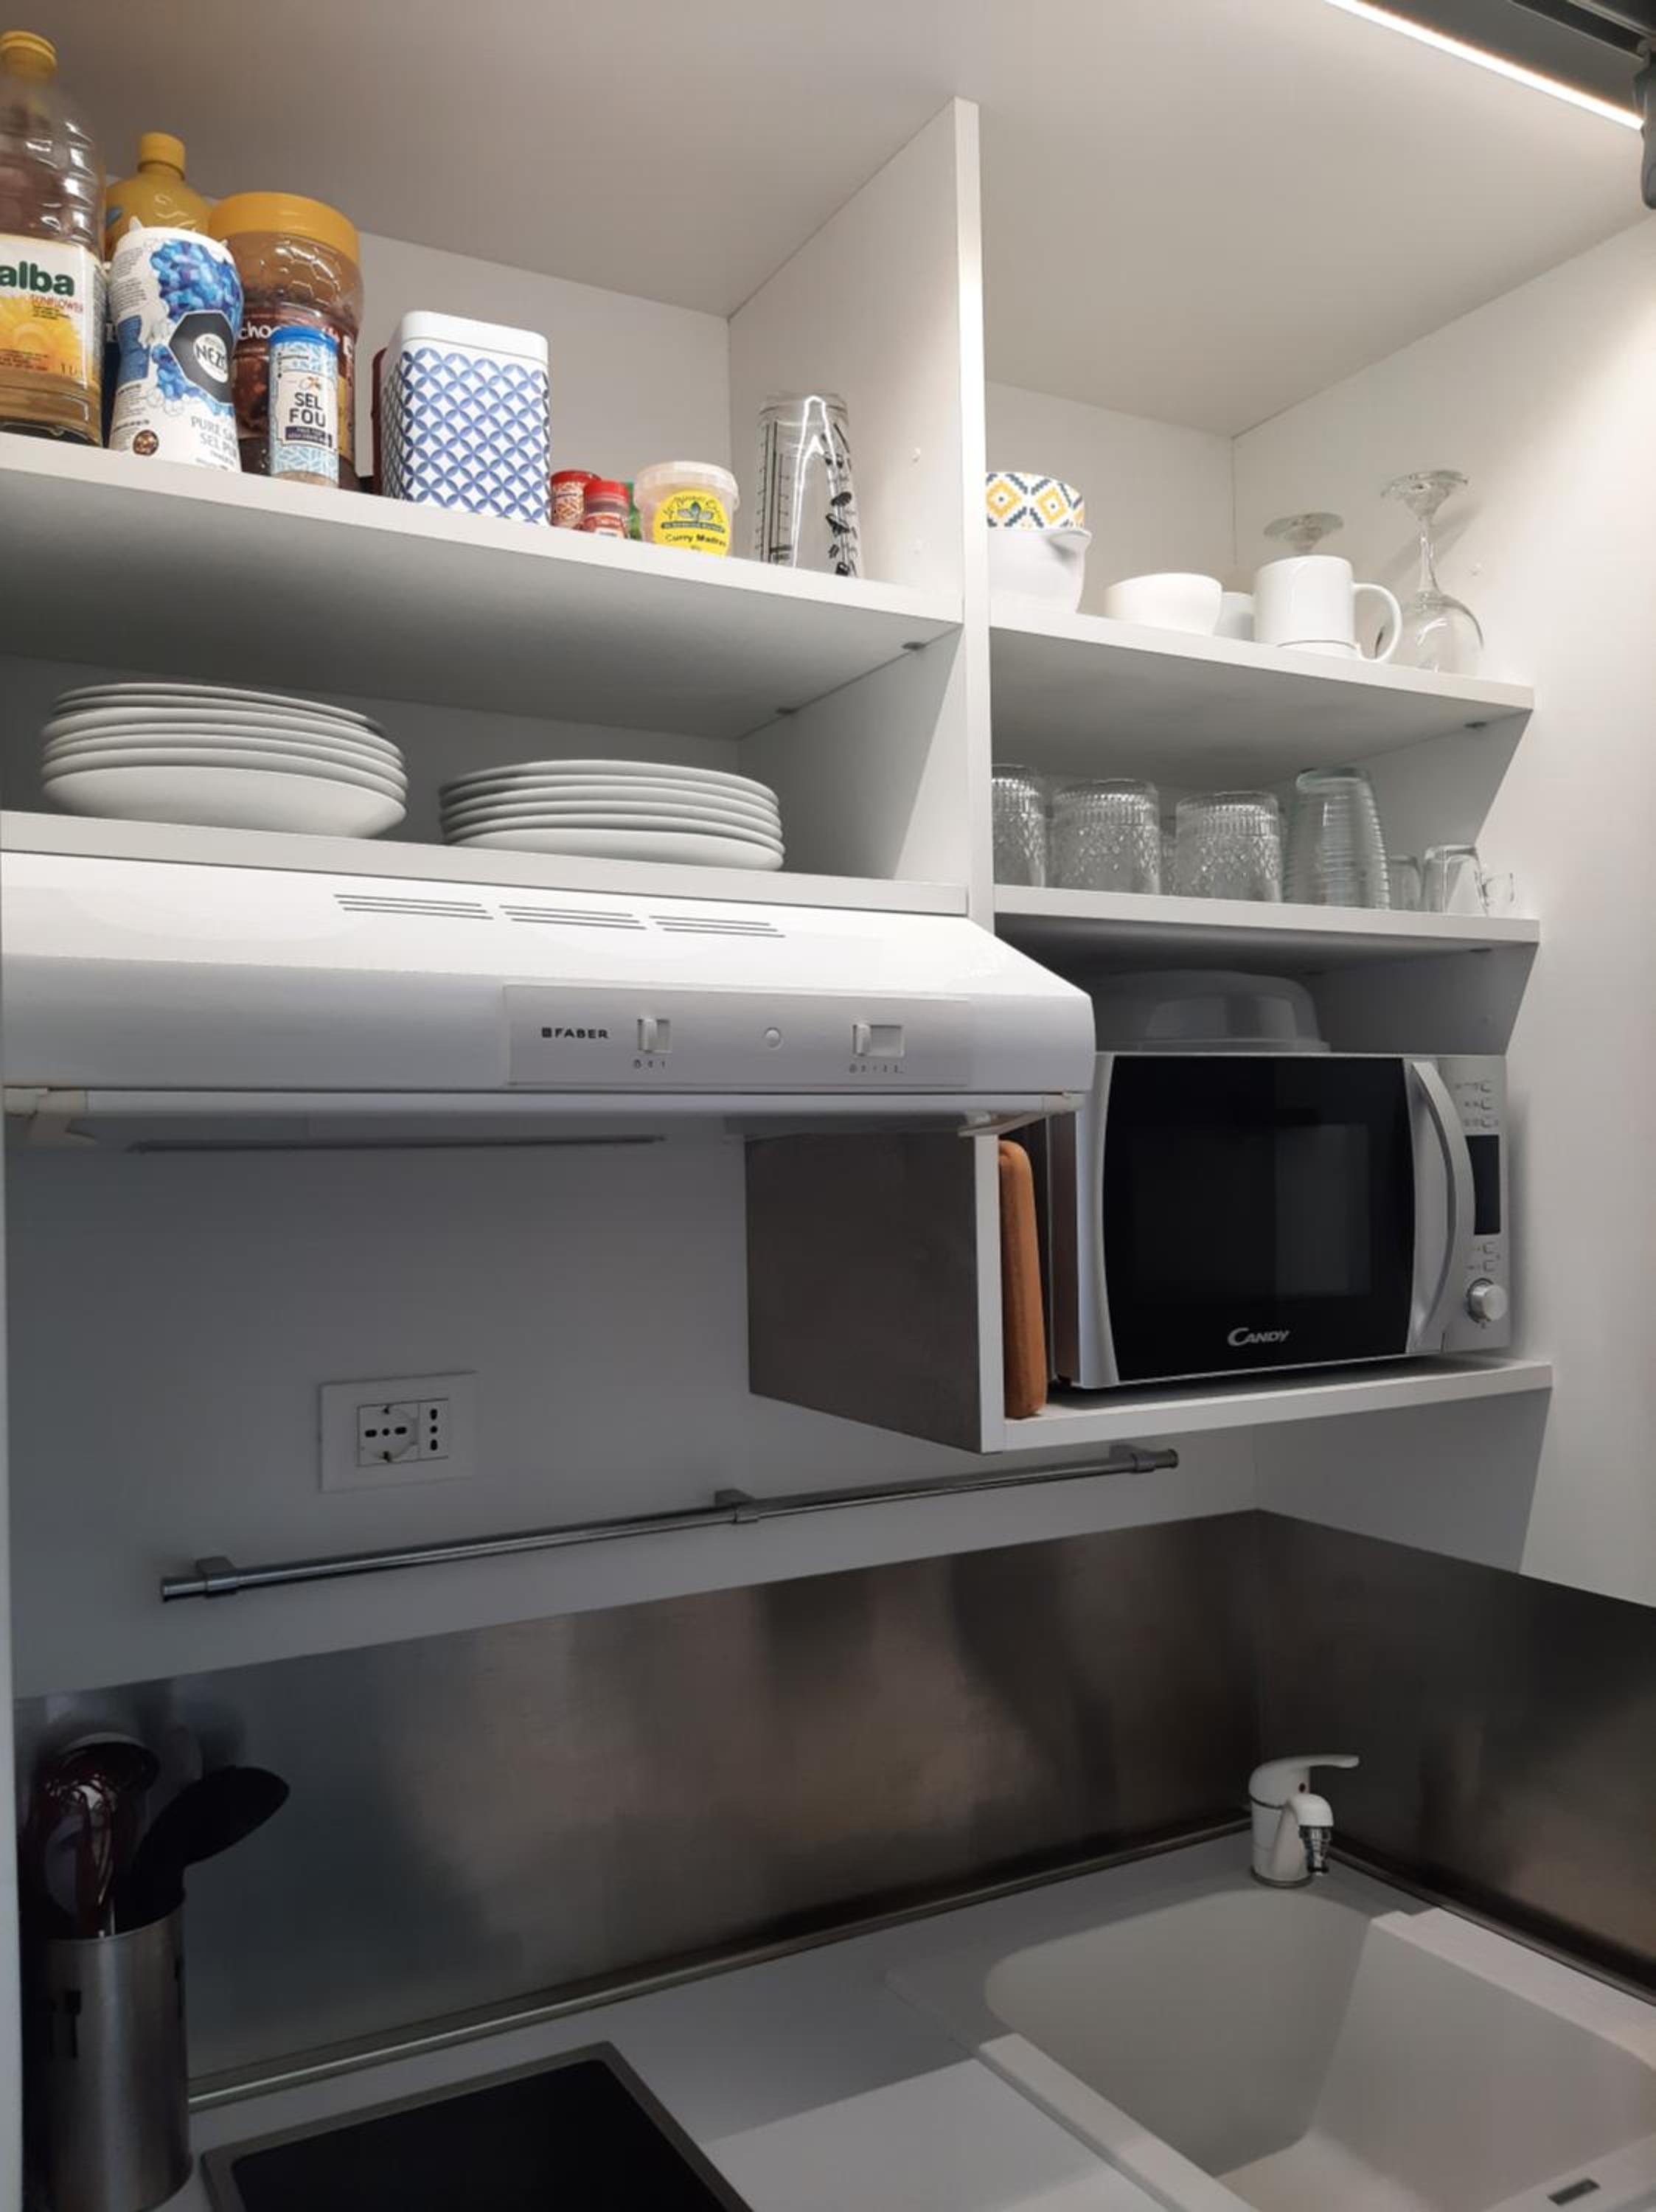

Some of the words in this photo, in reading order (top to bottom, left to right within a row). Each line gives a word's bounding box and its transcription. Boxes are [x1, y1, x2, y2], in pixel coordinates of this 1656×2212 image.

[295, 392, 323, 411] SEL
[289, 408, 326, 428] FOU
[665, 534, 693, 543] Curry
[554, 1028, 610, 1039] FABER
[1227, 1327, 1290, 1346] CANDY
